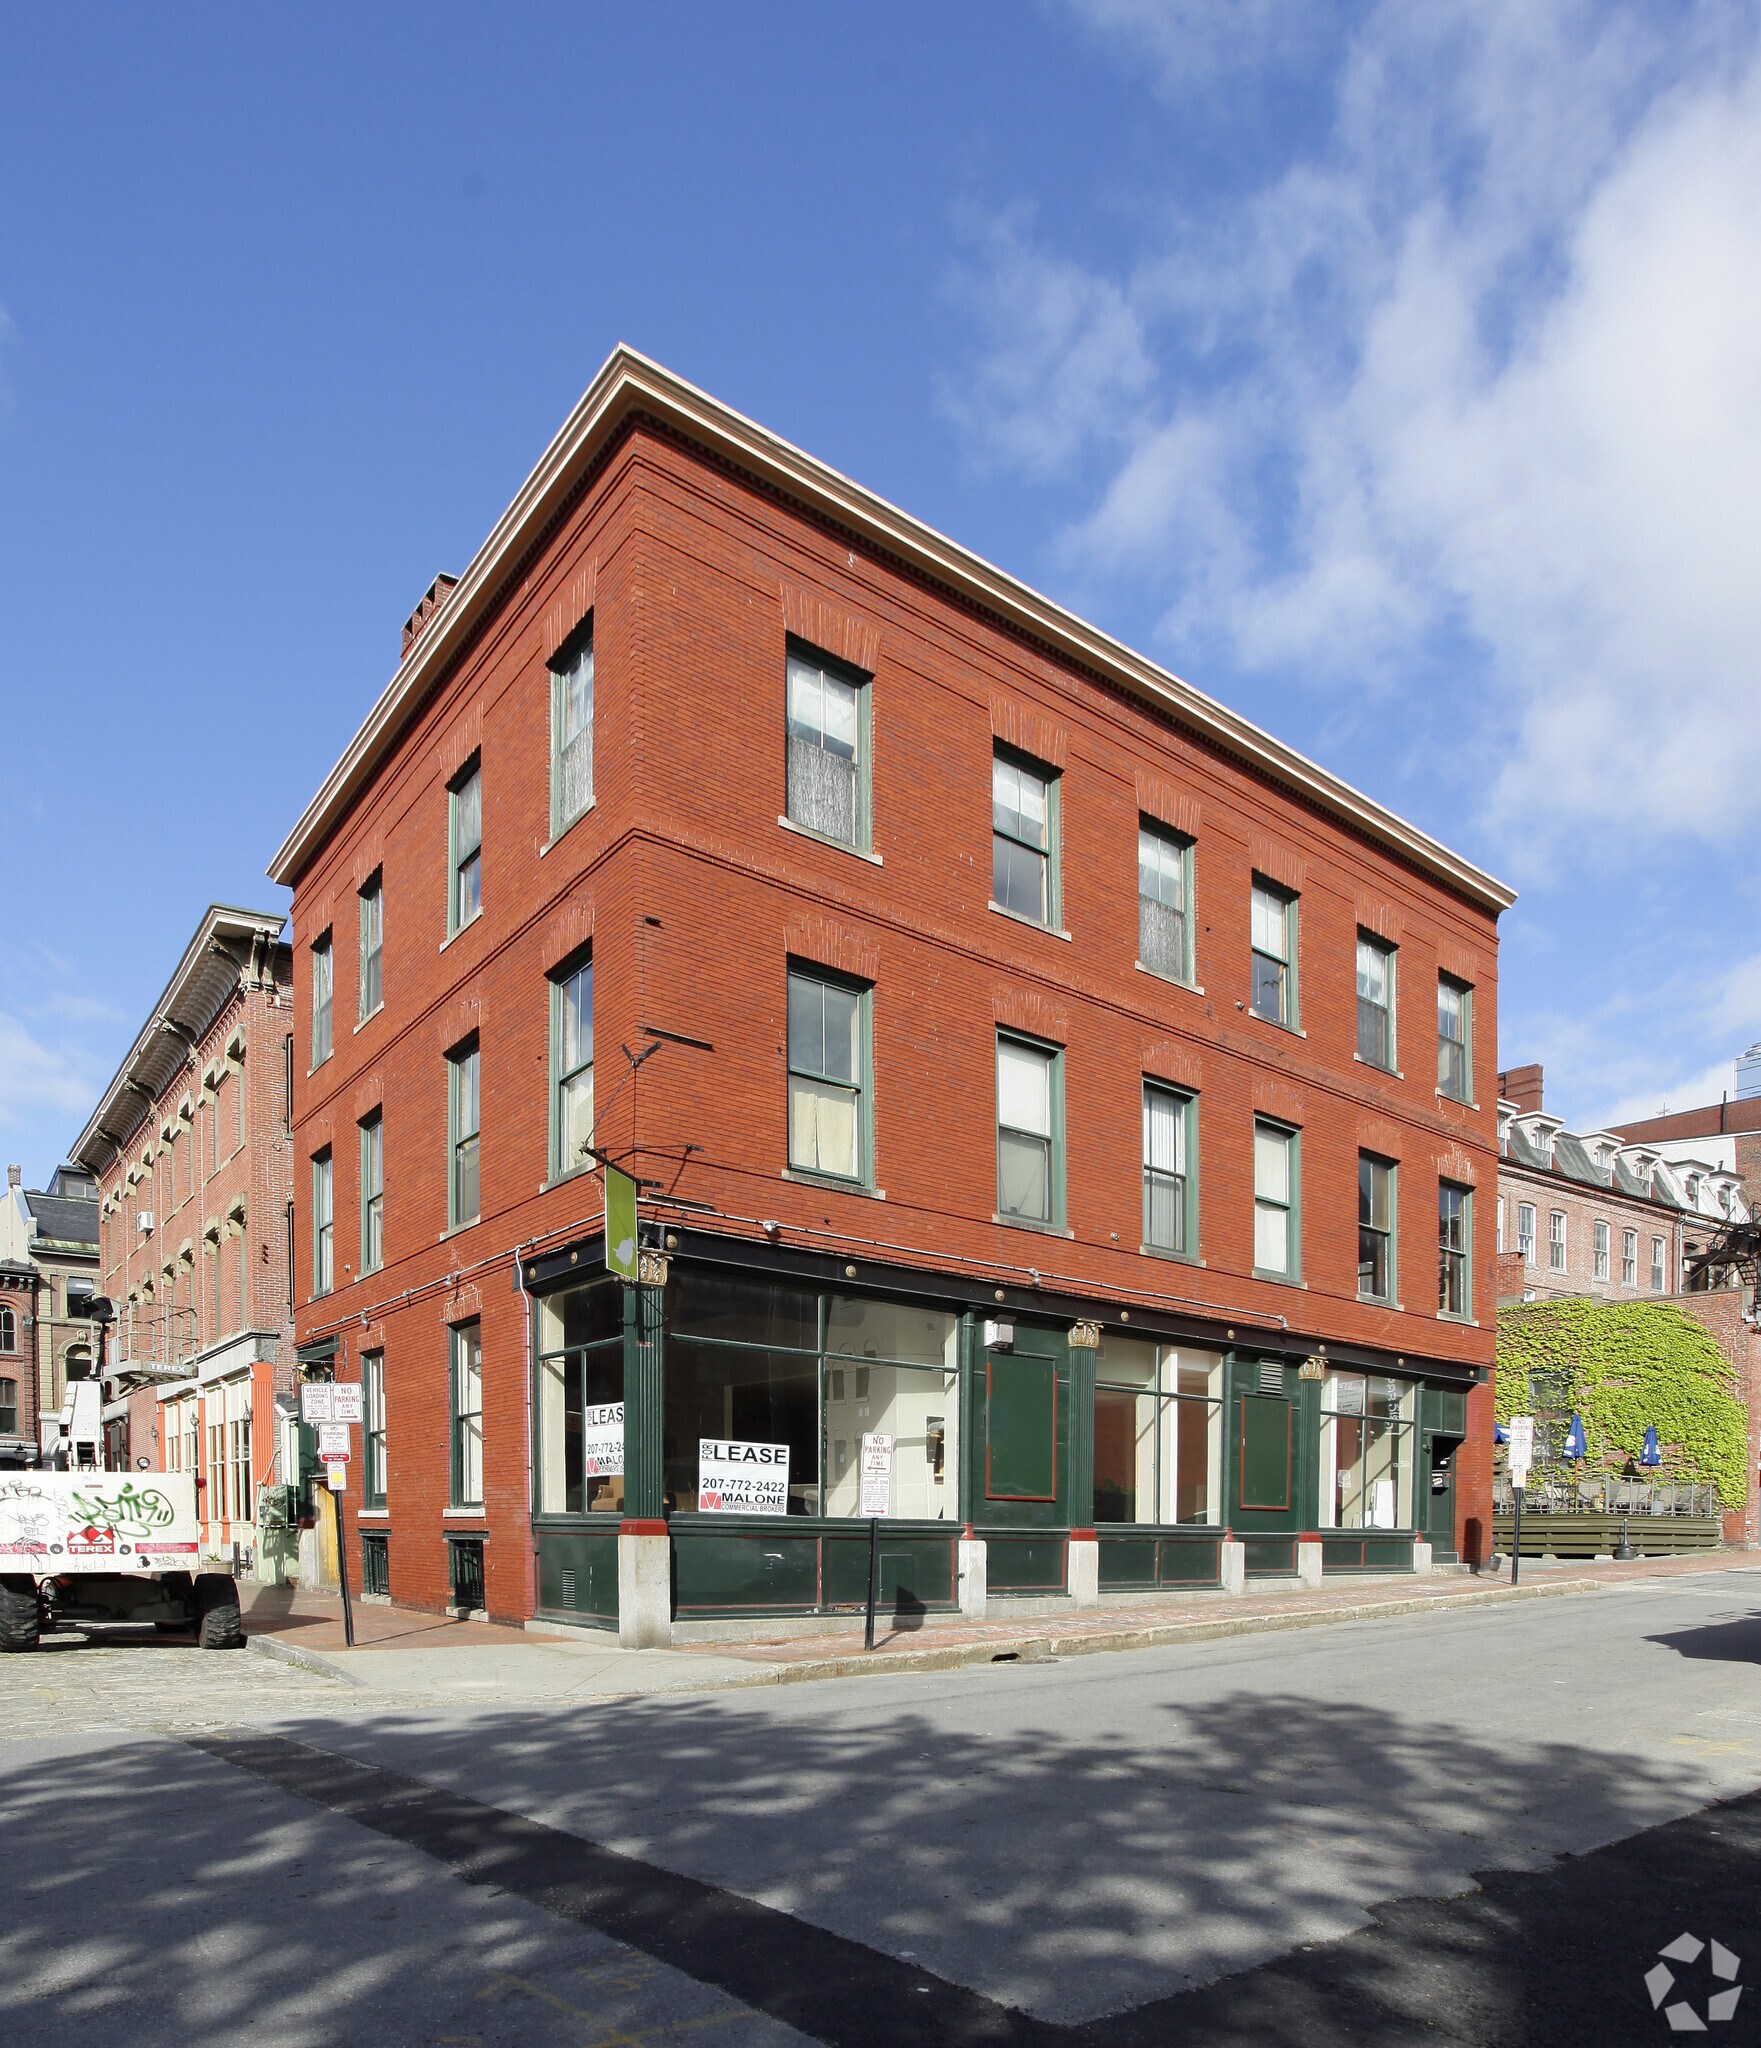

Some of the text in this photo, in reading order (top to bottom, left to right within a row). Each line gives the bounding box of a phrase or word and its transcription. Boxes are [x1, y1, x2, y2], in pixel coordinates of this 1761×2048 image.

[150, 1363, 186, 1373] TEREX
[334, 1395, 360, 1403] PARKING
[872, 1436, 884, 1445] NO
[702, 1443, 713, 1459] FOR
[713, 1444, 787, 1465] LEASE
[864, 1445, 891, 1454] PARKING
[702, 1477, 785, 1493] 207-772-2422
[721, 1492, 785, 1505] MALONE
[721, 1503, 785, 1513] COMMERCIAL BROKERS
[68, 1545, 113, 1553] TEREX
